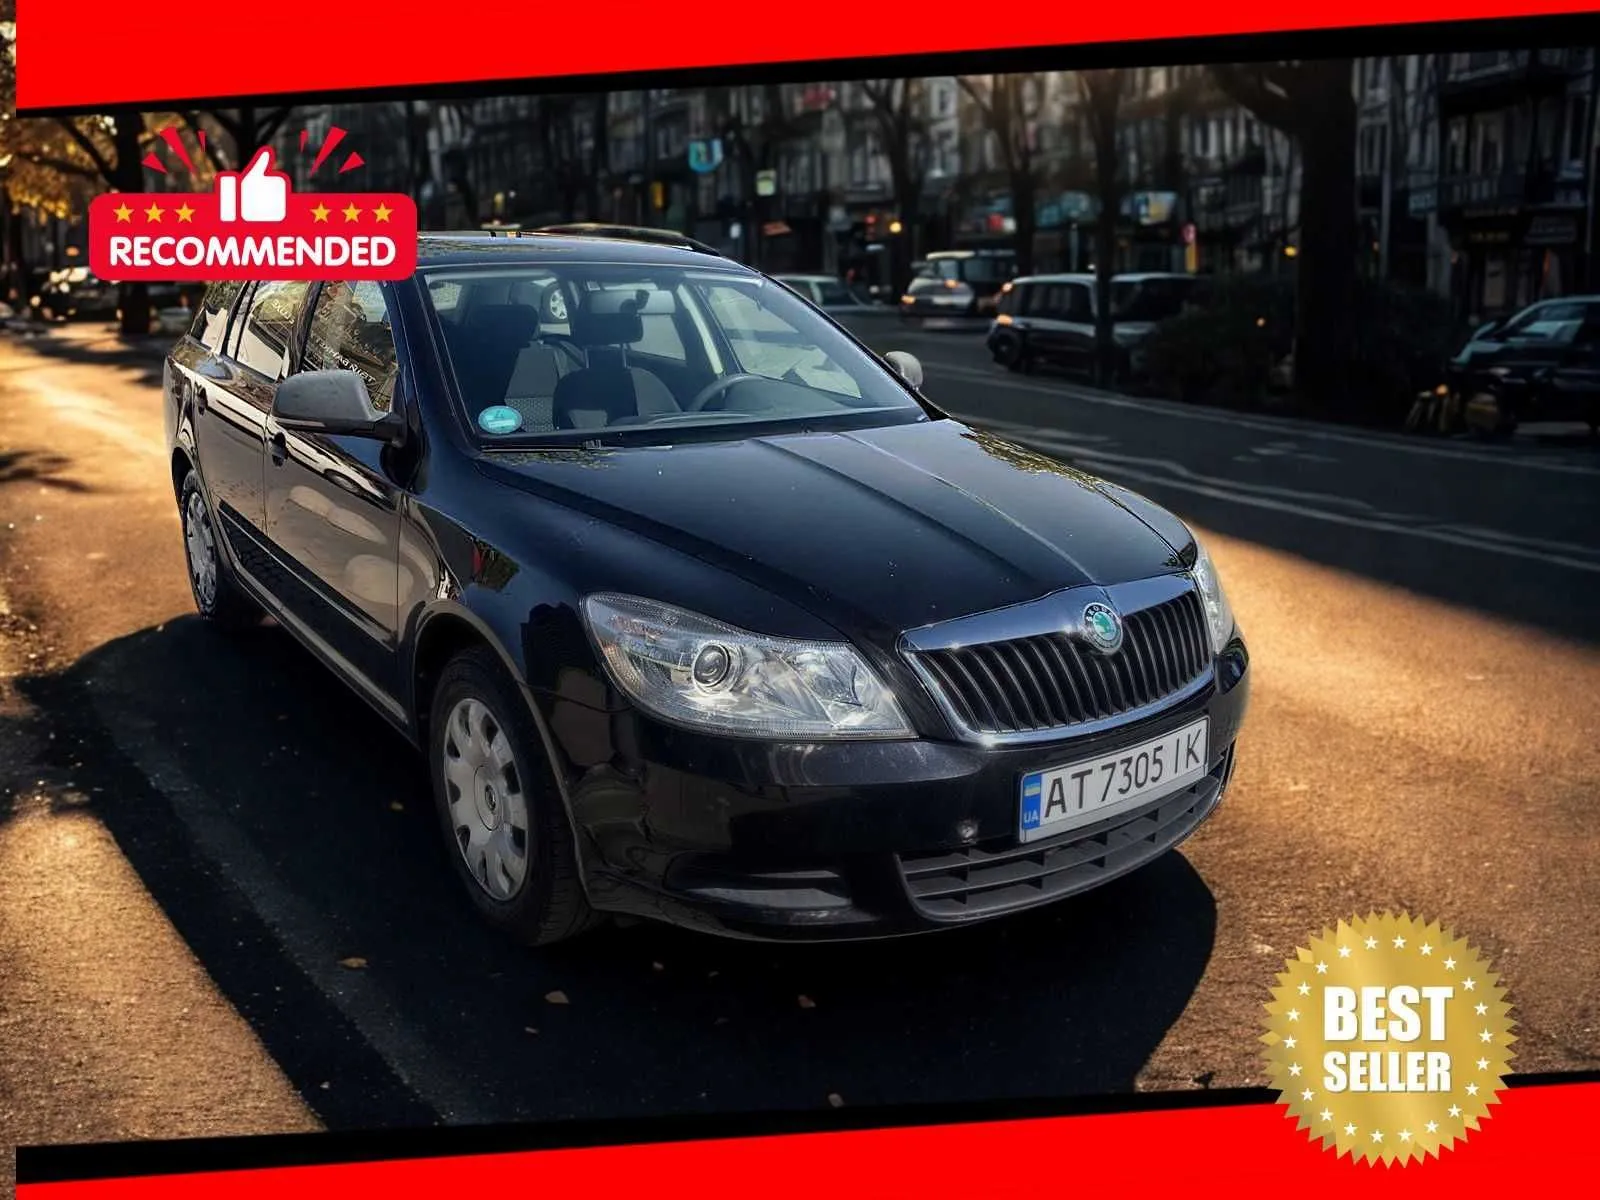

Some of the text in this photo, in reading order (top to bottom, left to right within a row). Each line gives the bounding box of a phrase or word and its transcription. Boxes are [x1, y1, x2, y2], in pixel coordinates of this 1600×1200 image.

[1045, 728, 1201, 817] AT 7305 IK
[1024, 811, 1039, 824] UA
